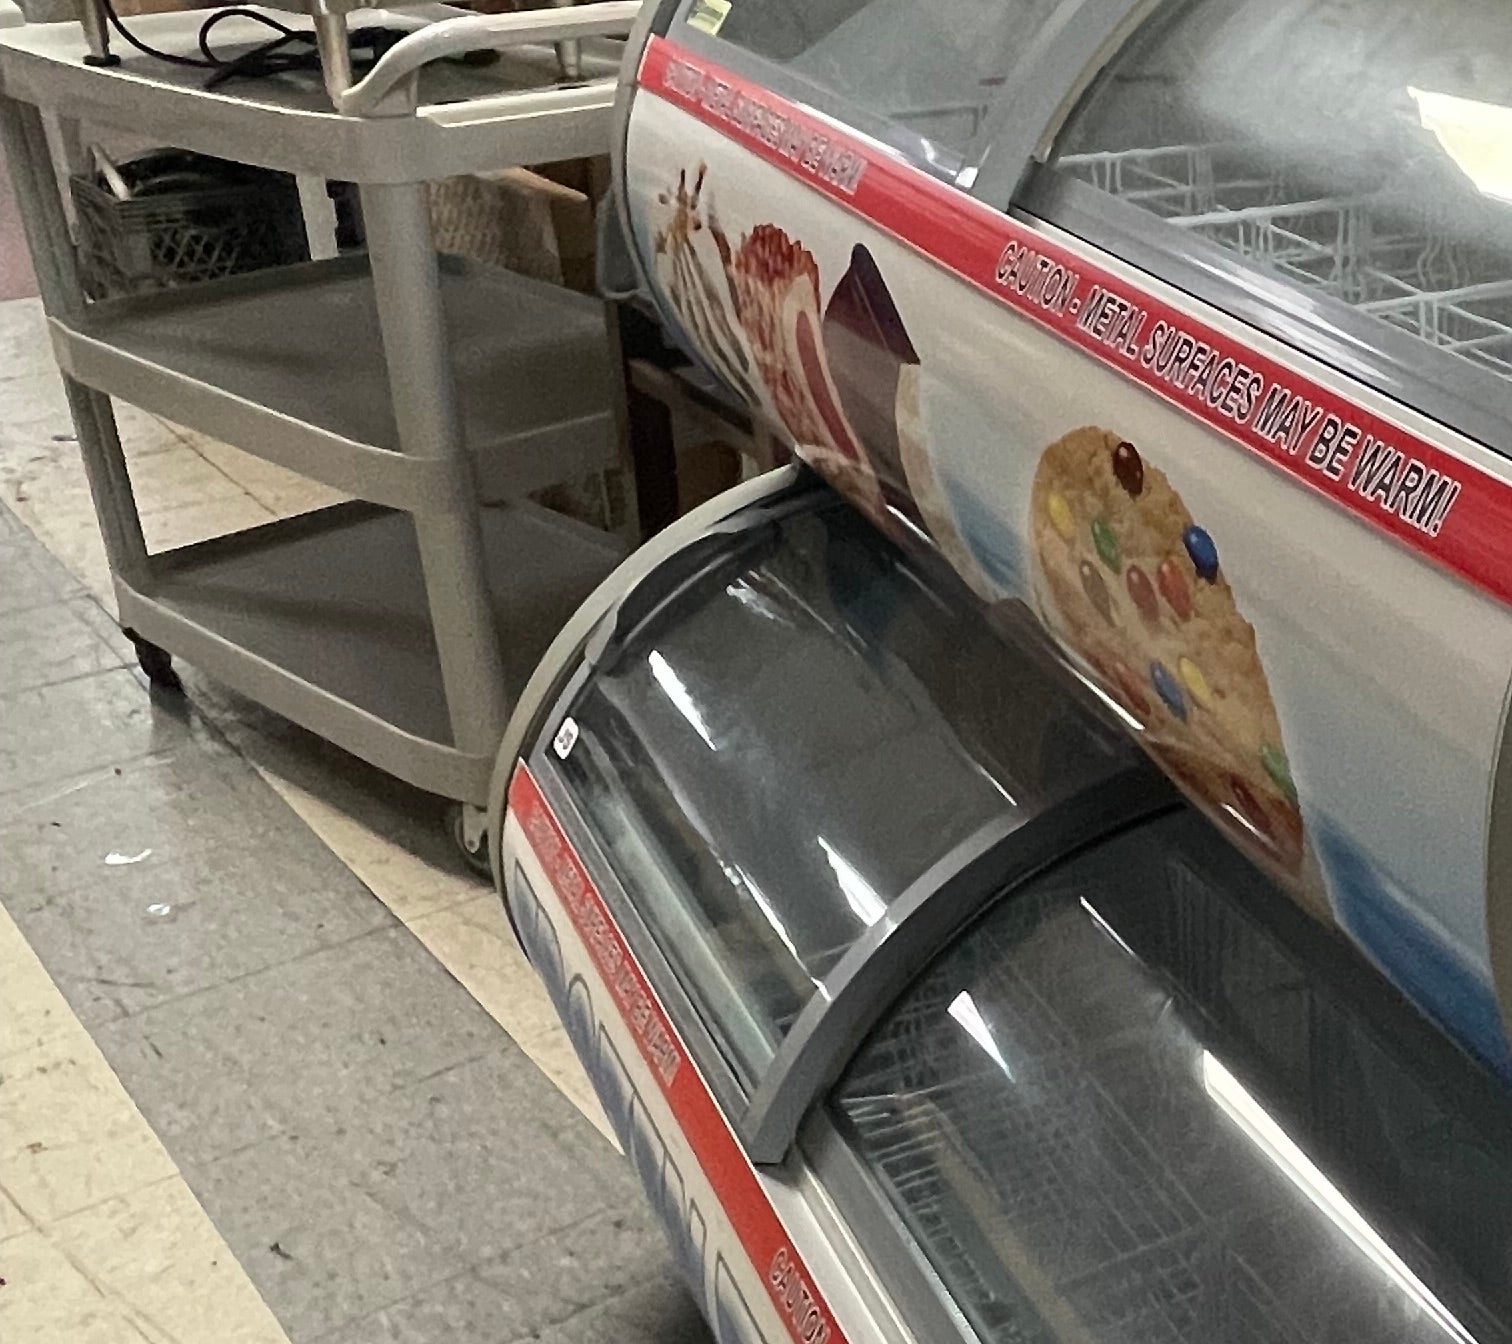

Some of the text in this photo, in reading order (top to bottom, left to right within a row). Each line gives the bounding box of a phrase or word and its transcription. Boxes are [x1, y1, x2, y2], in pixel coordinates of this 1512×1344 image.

[995, 239, 1080, 318] CAUTION
[1077, 284, 1148, 360] METAL
[1140, 319, 1264, 424] SURFACES
[1251, 382, 1324, 456] MAY
[1304, 412, 1362, 482] BE
[1347, 433, 1462, 538] WARM!
